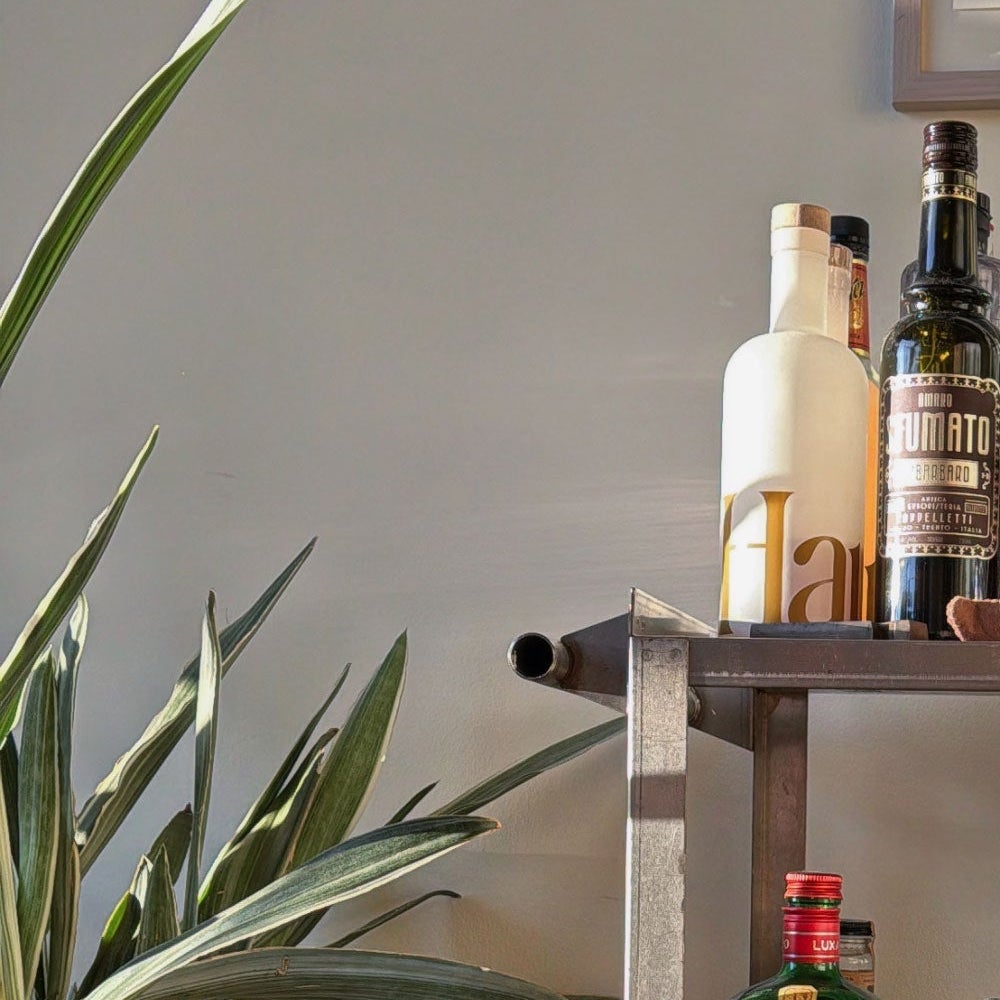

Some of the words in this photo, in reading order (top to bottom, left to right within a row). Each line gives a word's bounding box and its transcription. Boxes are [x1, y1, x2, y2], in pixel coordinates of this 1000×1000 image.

[918, 392, 952, 408] AMARO
[908, 464, 969, 482] BARBARO
[895, 512, 972, 525] APPELLETTI
